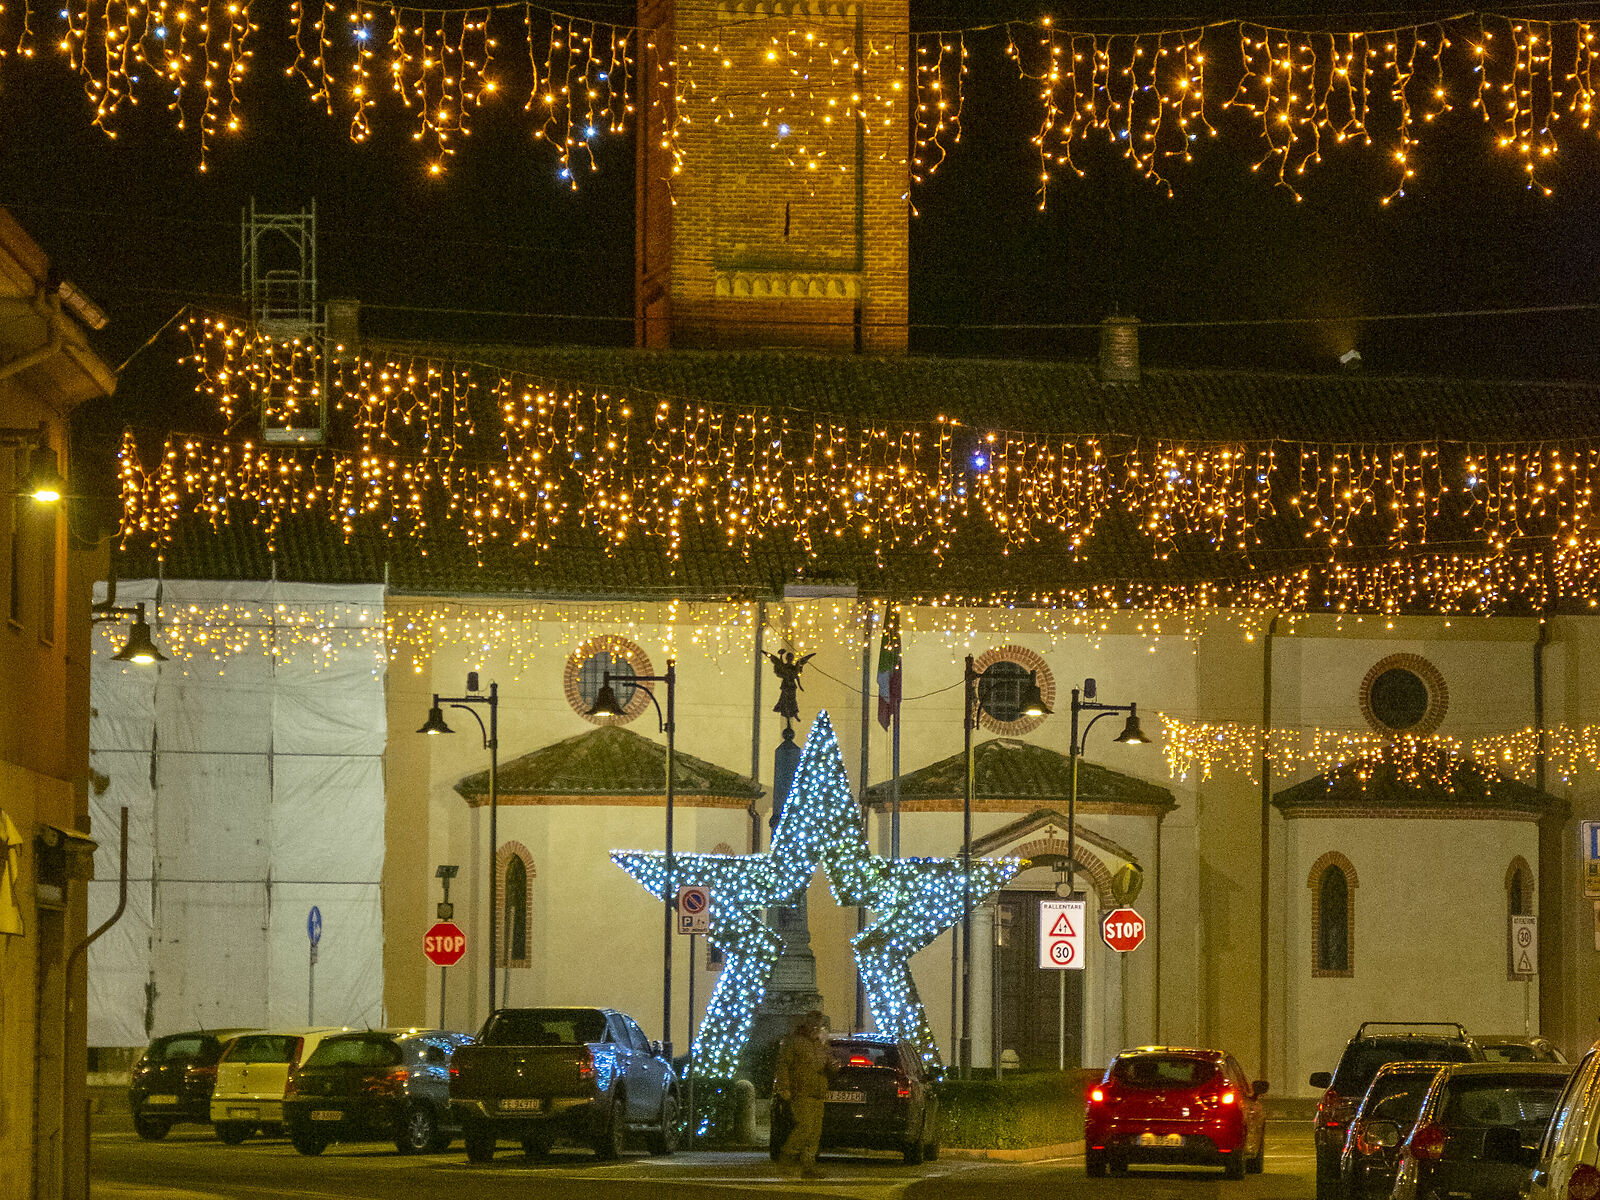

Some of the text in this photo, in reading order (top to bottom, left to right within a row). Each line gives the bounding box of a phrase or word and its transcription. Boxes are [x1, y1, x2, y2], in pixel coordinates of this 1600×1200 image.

[1106, 922, 1143, 939] STOP
[1520, 932, 1529, 942] 30
[425, 936, 464, 953] STOP
[1055, 946, 1070, 959] 30
